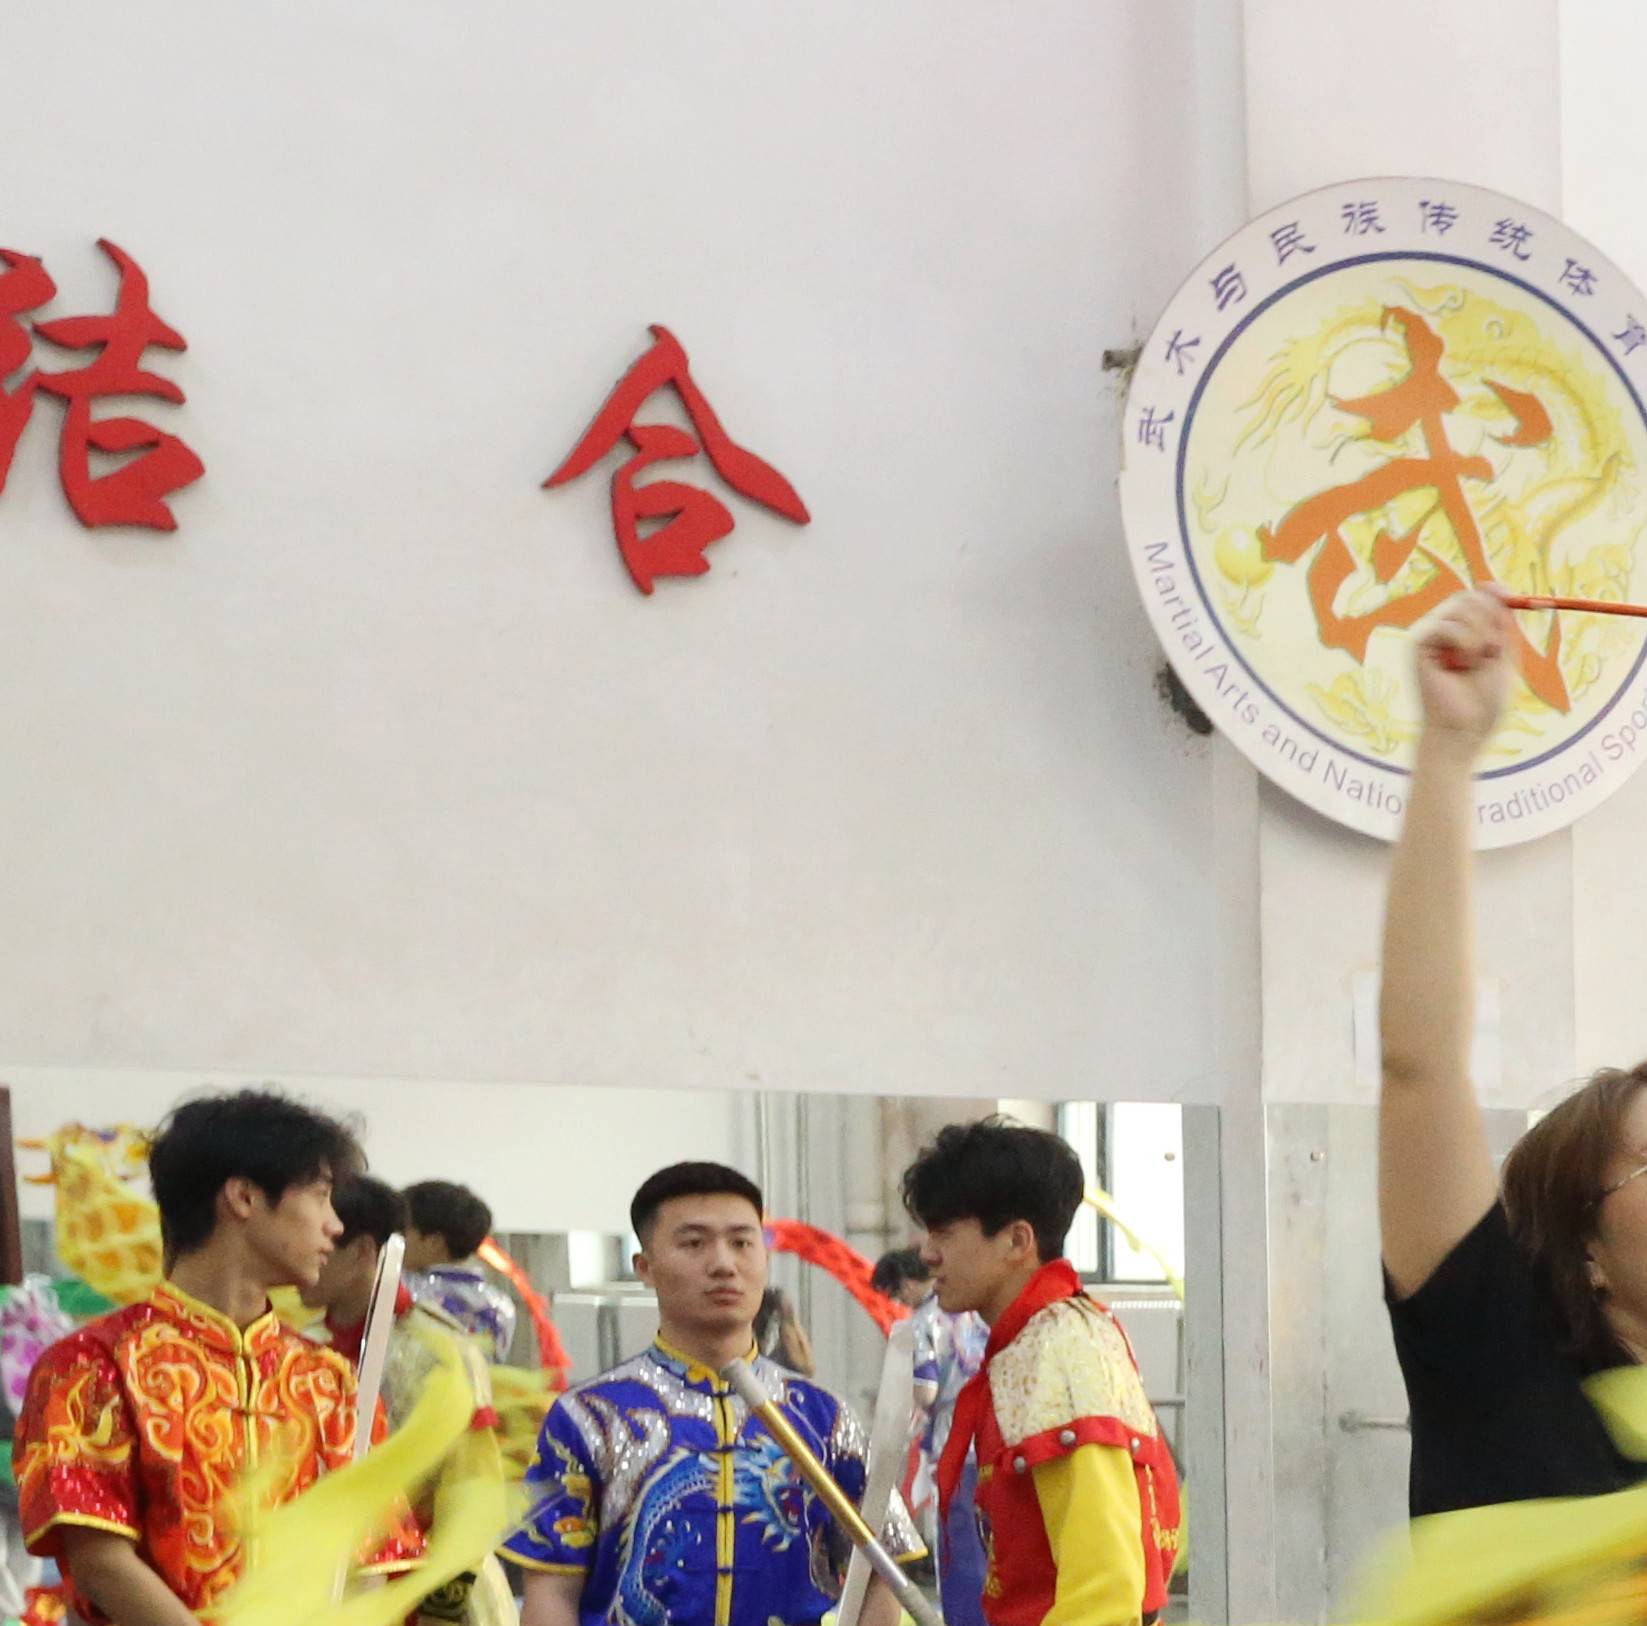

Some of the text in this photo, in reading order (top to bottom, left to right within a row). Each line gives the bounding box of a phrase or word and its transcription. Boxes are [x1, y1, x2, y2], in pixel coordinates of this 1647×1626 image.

[1143, 541, 1214, 660] Martial
[1204, 664, 1260, 725] Arts
[1262, 723, 1319, 773] and
[1322, 758, 1403, 816] Natio
[1477, 750, 1604, 825] raditional
